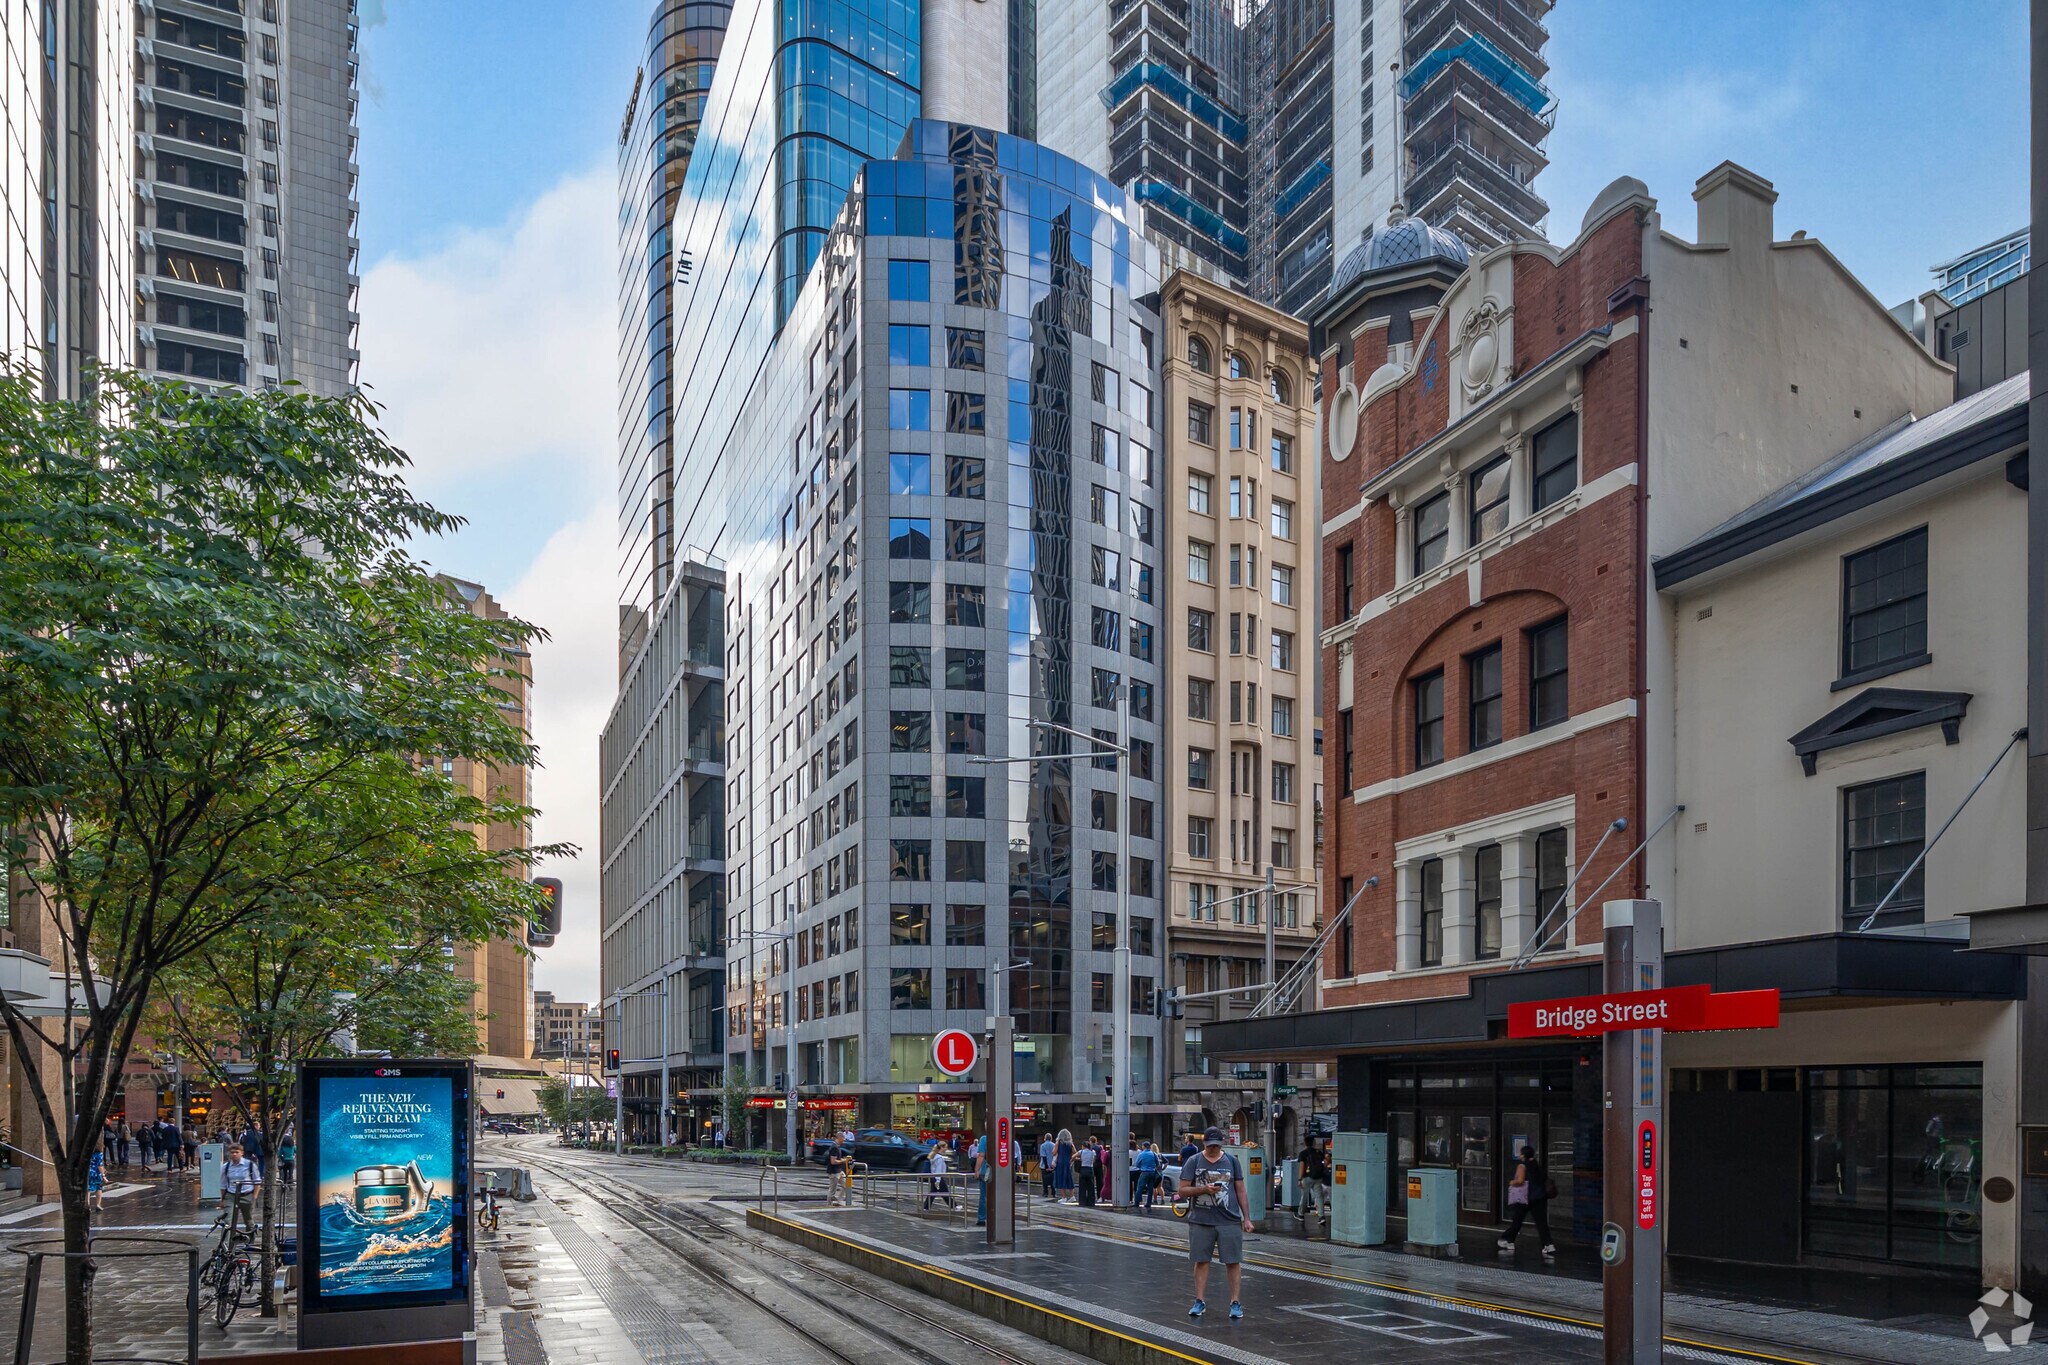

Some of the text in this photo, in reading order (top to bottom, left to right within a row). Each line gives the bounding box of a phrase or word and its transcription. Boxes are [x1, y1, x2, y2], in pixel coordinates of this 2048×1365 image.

[1536, 999, 1668, 1030] Bridge Street
[948, 1039, 965, 1065] L
[360, 1094, 415, 1103] THE NEW
[343, 1104, 431, 1114] REJUVENATING
[353, 1114, 421, 1124] EYE CREAM
